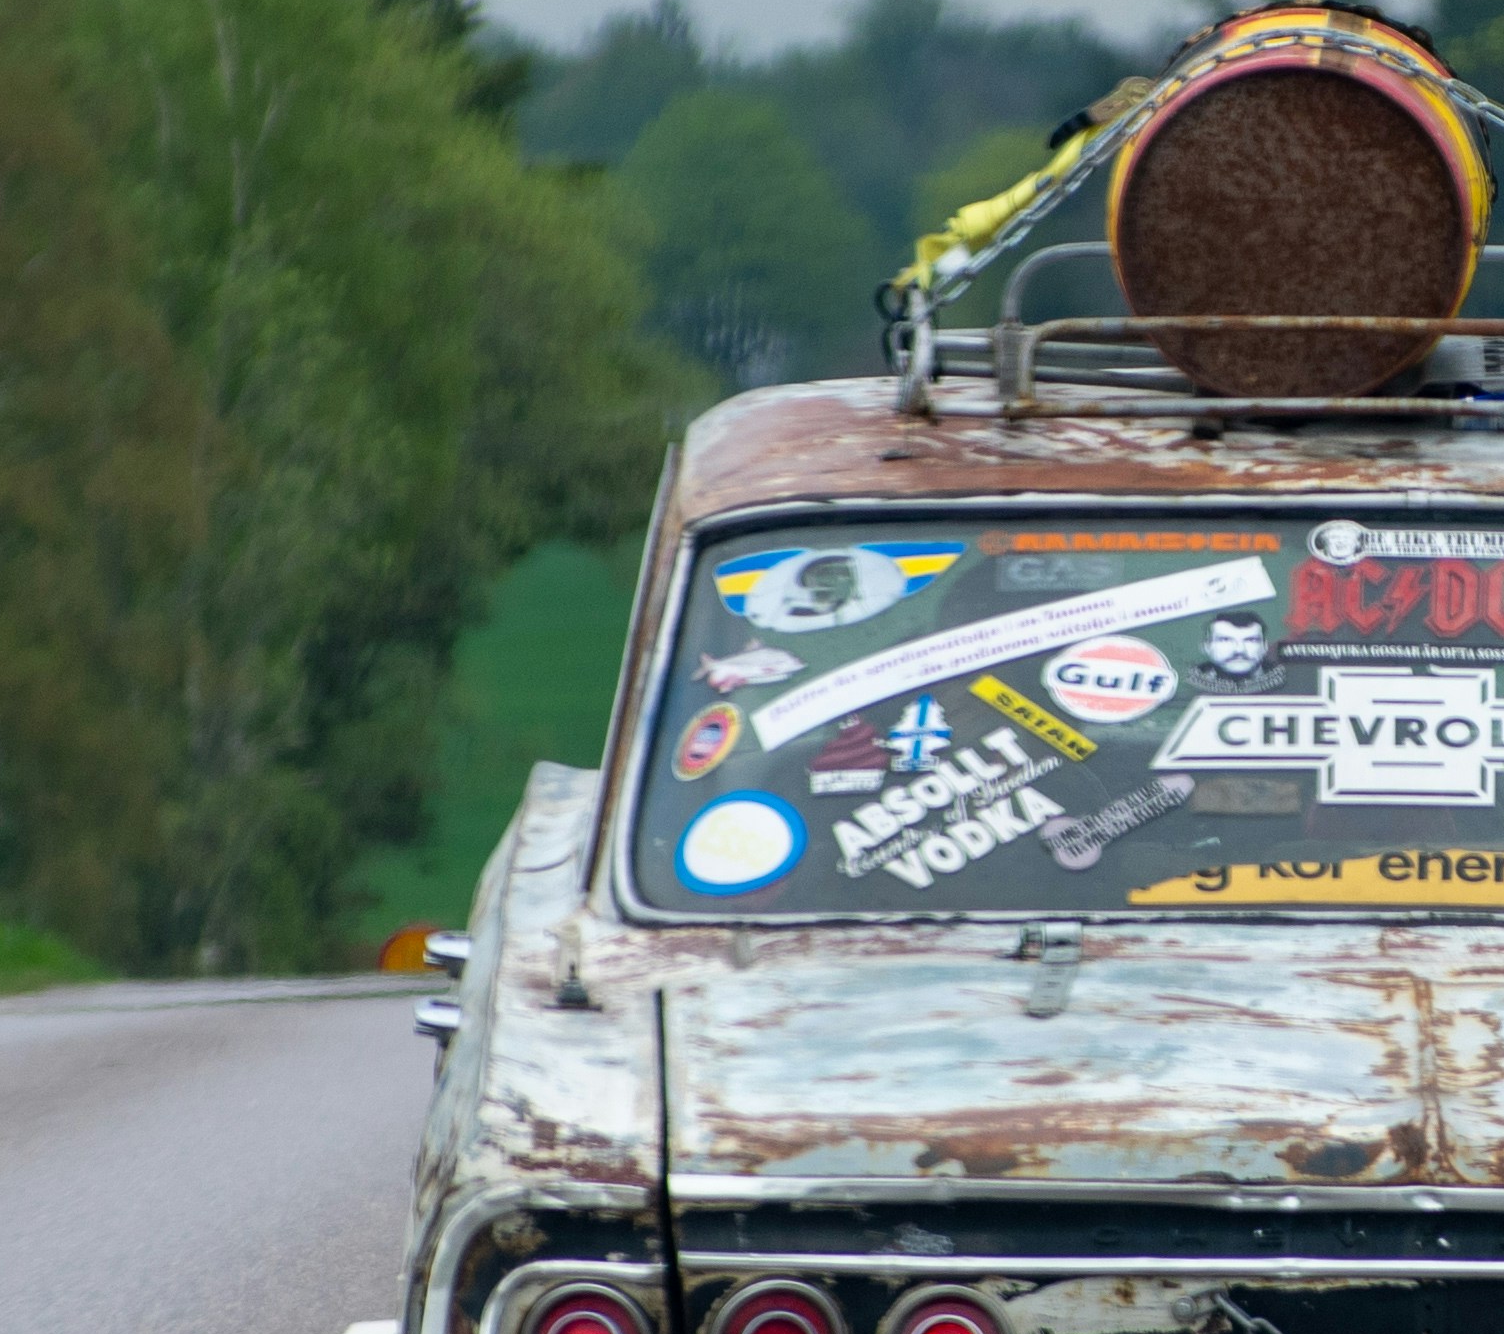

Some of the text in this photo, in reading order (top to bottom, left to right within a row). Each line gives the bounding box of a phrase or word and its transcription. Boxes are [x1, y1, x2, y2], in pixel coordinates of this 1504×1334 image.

[1393, 533, 1436, 544] LIKE
[1282, 643, 1369, 659] AVUNDSJUKA
[1370, 644, 1422, 659] GOSSAR
[1422, 643, 1441, 659] ÄR
[1441, 647, 1476, 661] OFTA
[1057, 663, 1169, 693] Gulf
[996, 692, 1088, 755] SATAN
[883, 785, 1067, 889] VODKA
